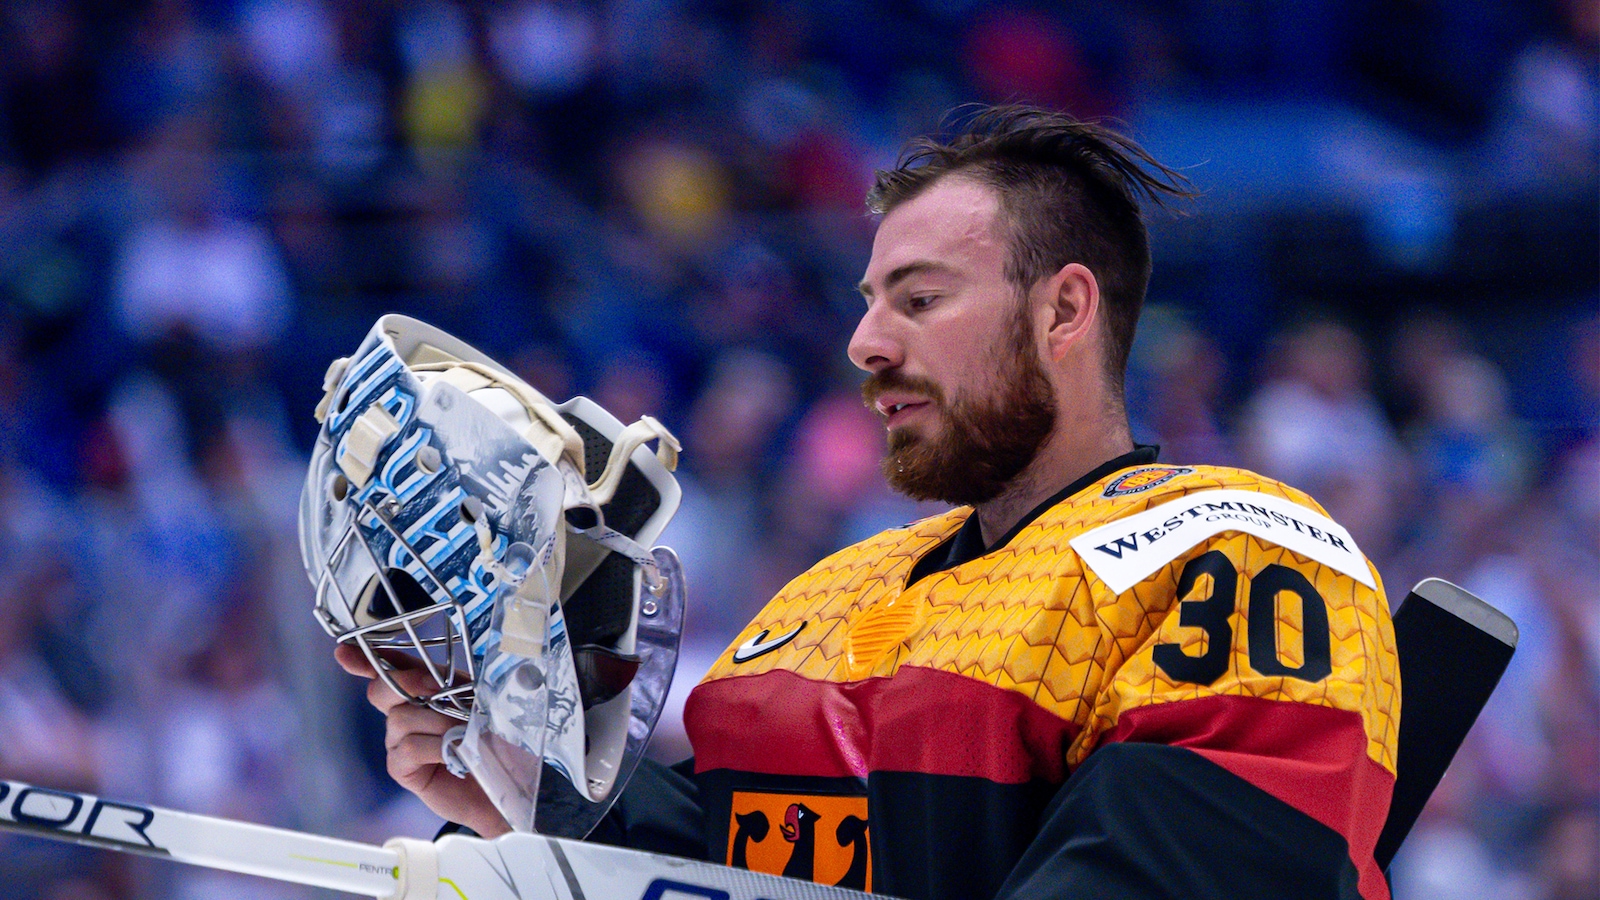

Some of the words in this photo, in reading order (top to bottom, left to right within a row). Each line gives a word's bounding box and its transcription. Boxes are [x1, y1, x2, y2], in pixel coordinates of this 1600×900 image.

[1094, 501, 1352, 560] WESTMINSTER
[1206, 512, 1271, 529] GROUP
[1152, 550, 1333, 687] 30
